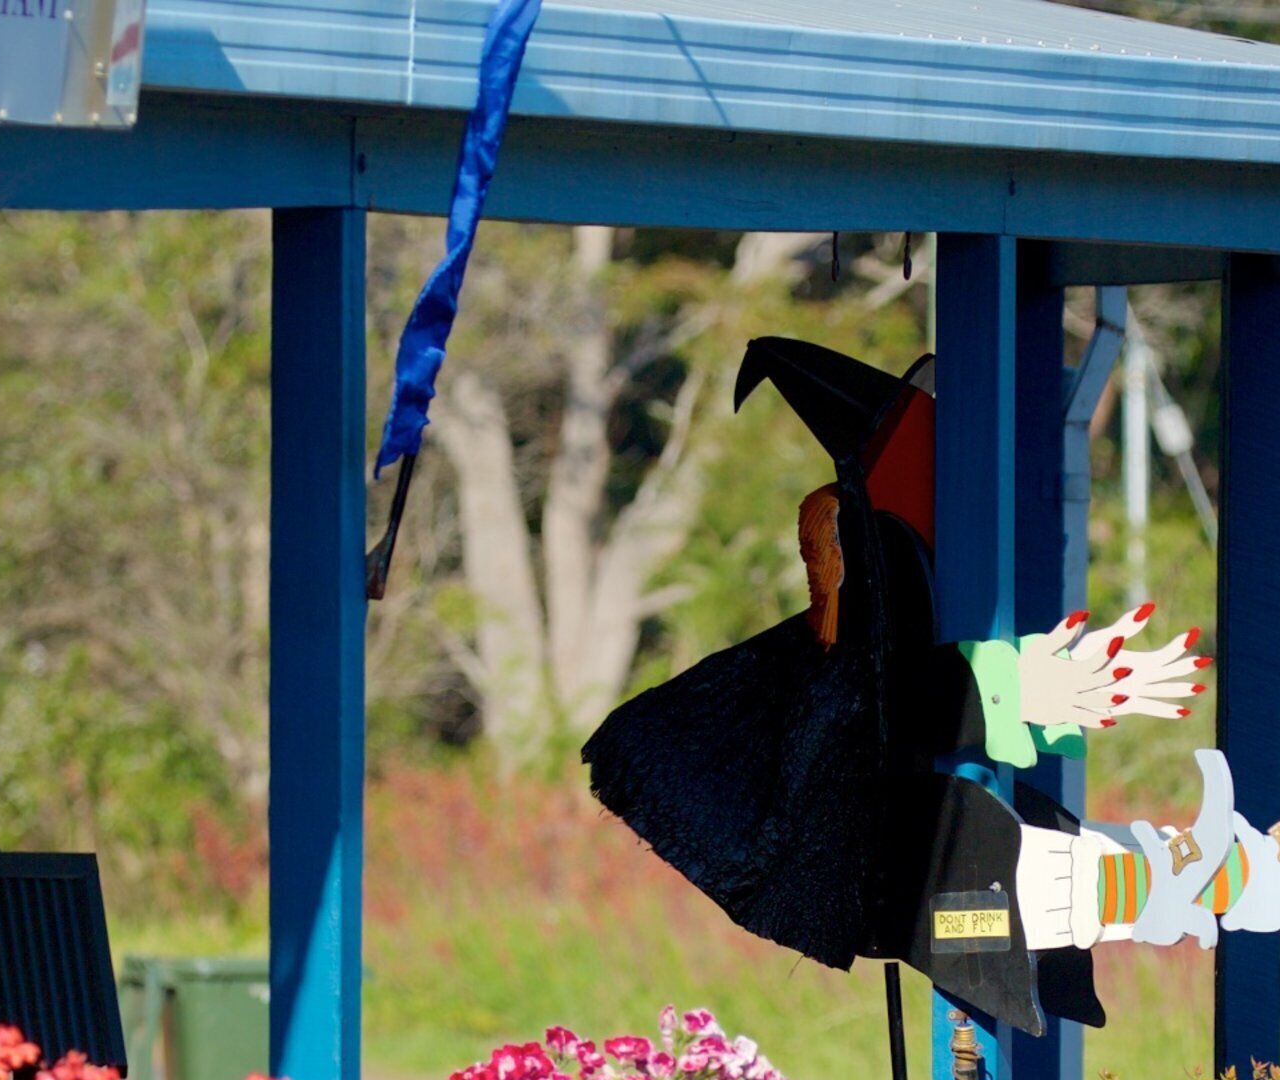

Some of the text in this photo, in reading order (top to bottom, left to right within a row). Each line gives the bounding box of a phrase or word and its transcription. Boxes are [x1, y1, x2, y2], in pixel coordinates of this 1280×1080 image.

[939, 912, 1003, 924] DONT DRINK
[945, 923, 994, 934] AND FLY
